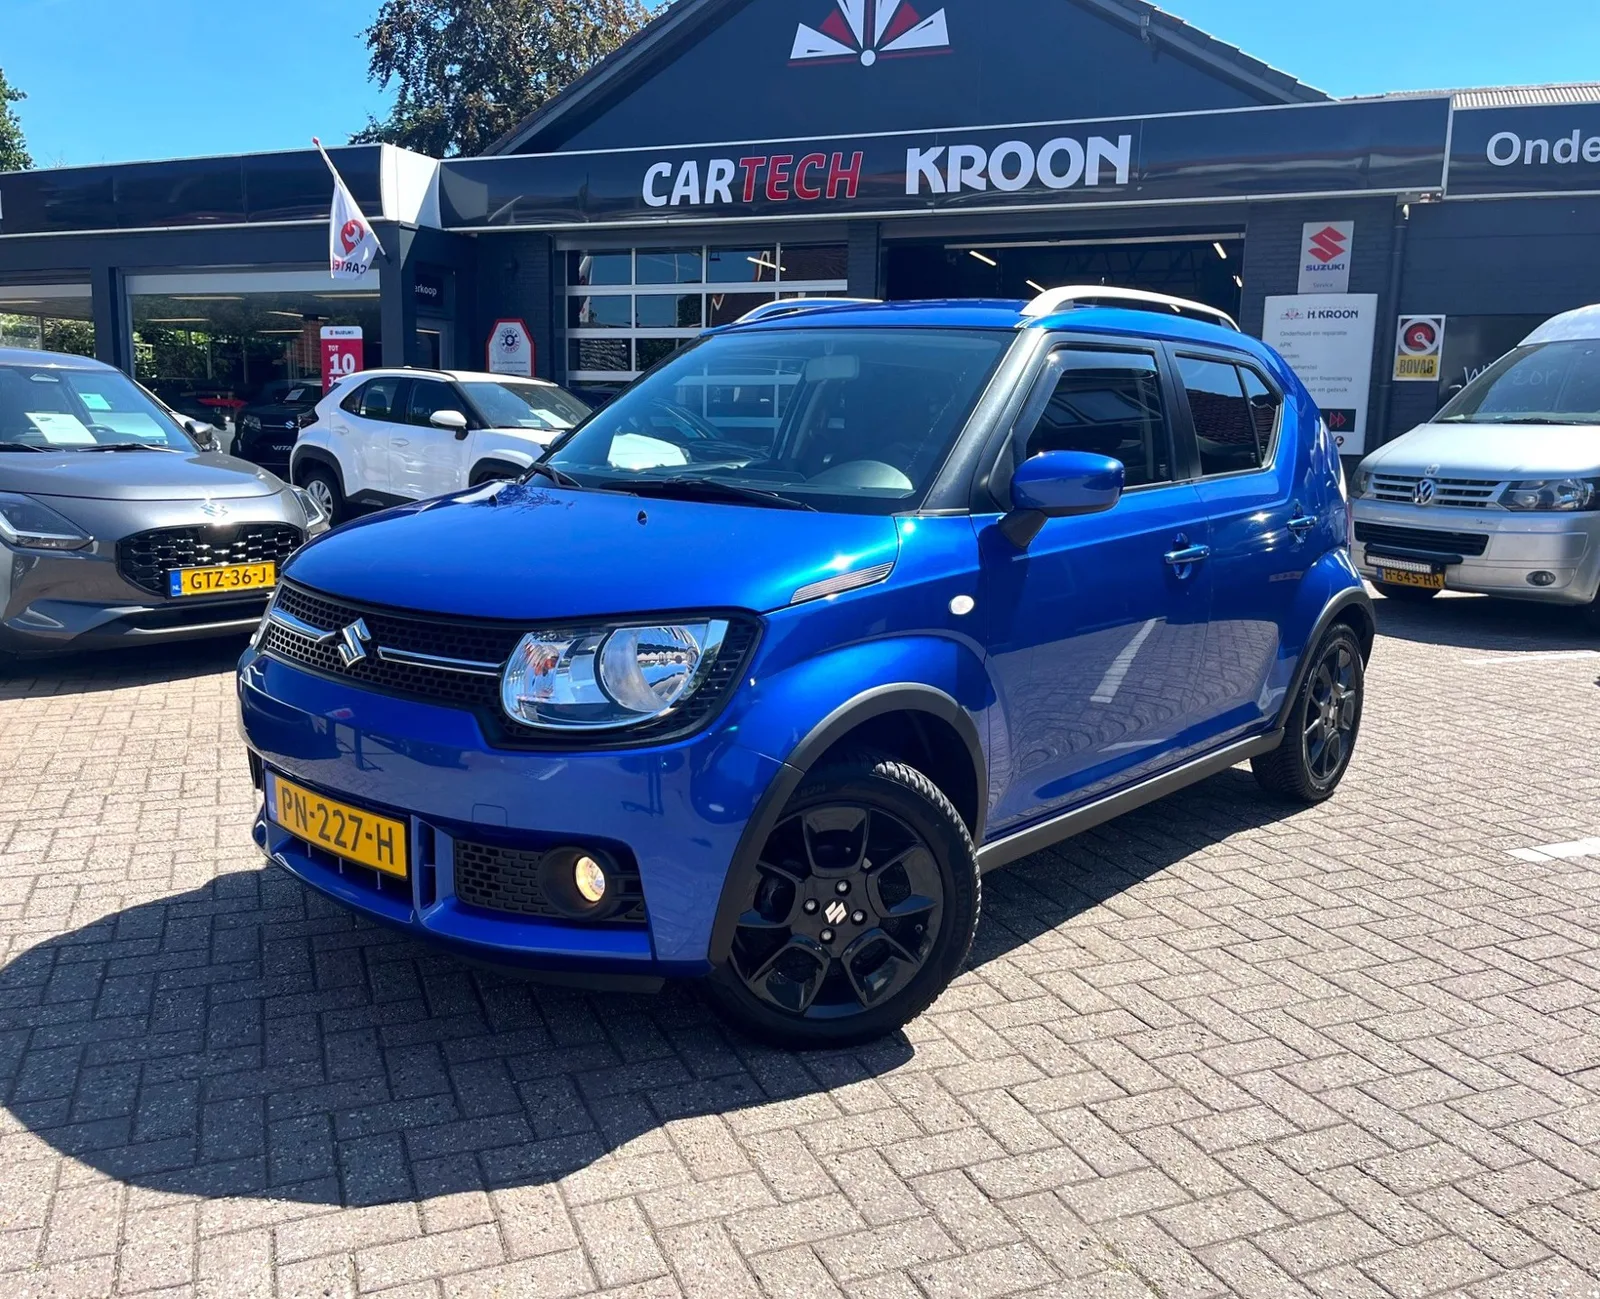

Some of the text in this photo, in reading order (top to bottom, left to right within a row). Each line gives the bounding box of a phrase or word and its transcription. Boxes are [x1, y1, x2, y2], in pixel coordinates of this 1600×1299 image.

[1486, 129, 1600, 167] Onde
[642, 134, 1132, 207] CARTECH KROON
[1305, 263, 1345, 272] SUZUKI
[414, 284, 438, 297] erkoop
[328, 353, 356, 375] 10
[1400, 359, 1434, 374] BOVAG
[190, 566, 267, 590] GTZ-36-J
[1385, 568, 1441, 587] H-645-HR
[281, 786, 394, 866] PN-227-H
